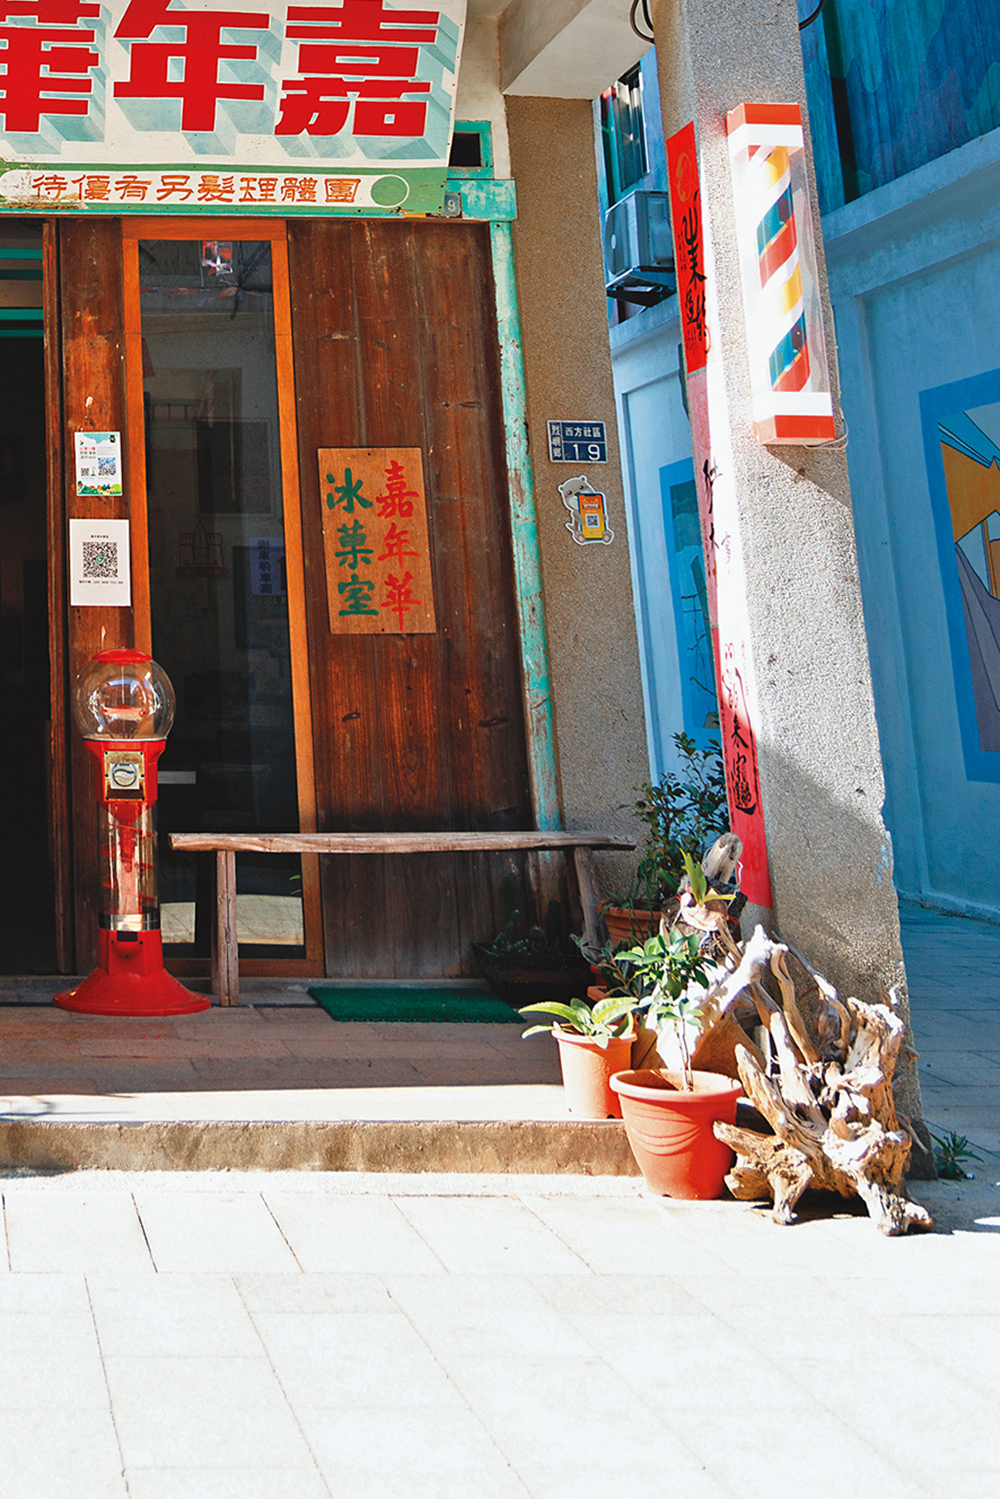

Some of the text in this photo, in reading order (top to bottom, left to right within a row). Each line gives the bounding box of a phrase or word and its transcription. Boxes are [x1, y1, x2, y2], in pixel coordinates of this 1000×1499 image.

[565, 427, 601, 438] 西方社區
[572, 444, 600, 460] 19
[326, 468, 379, 617] 冰菓室
[376, 460, 423, 632] 嘉年華
